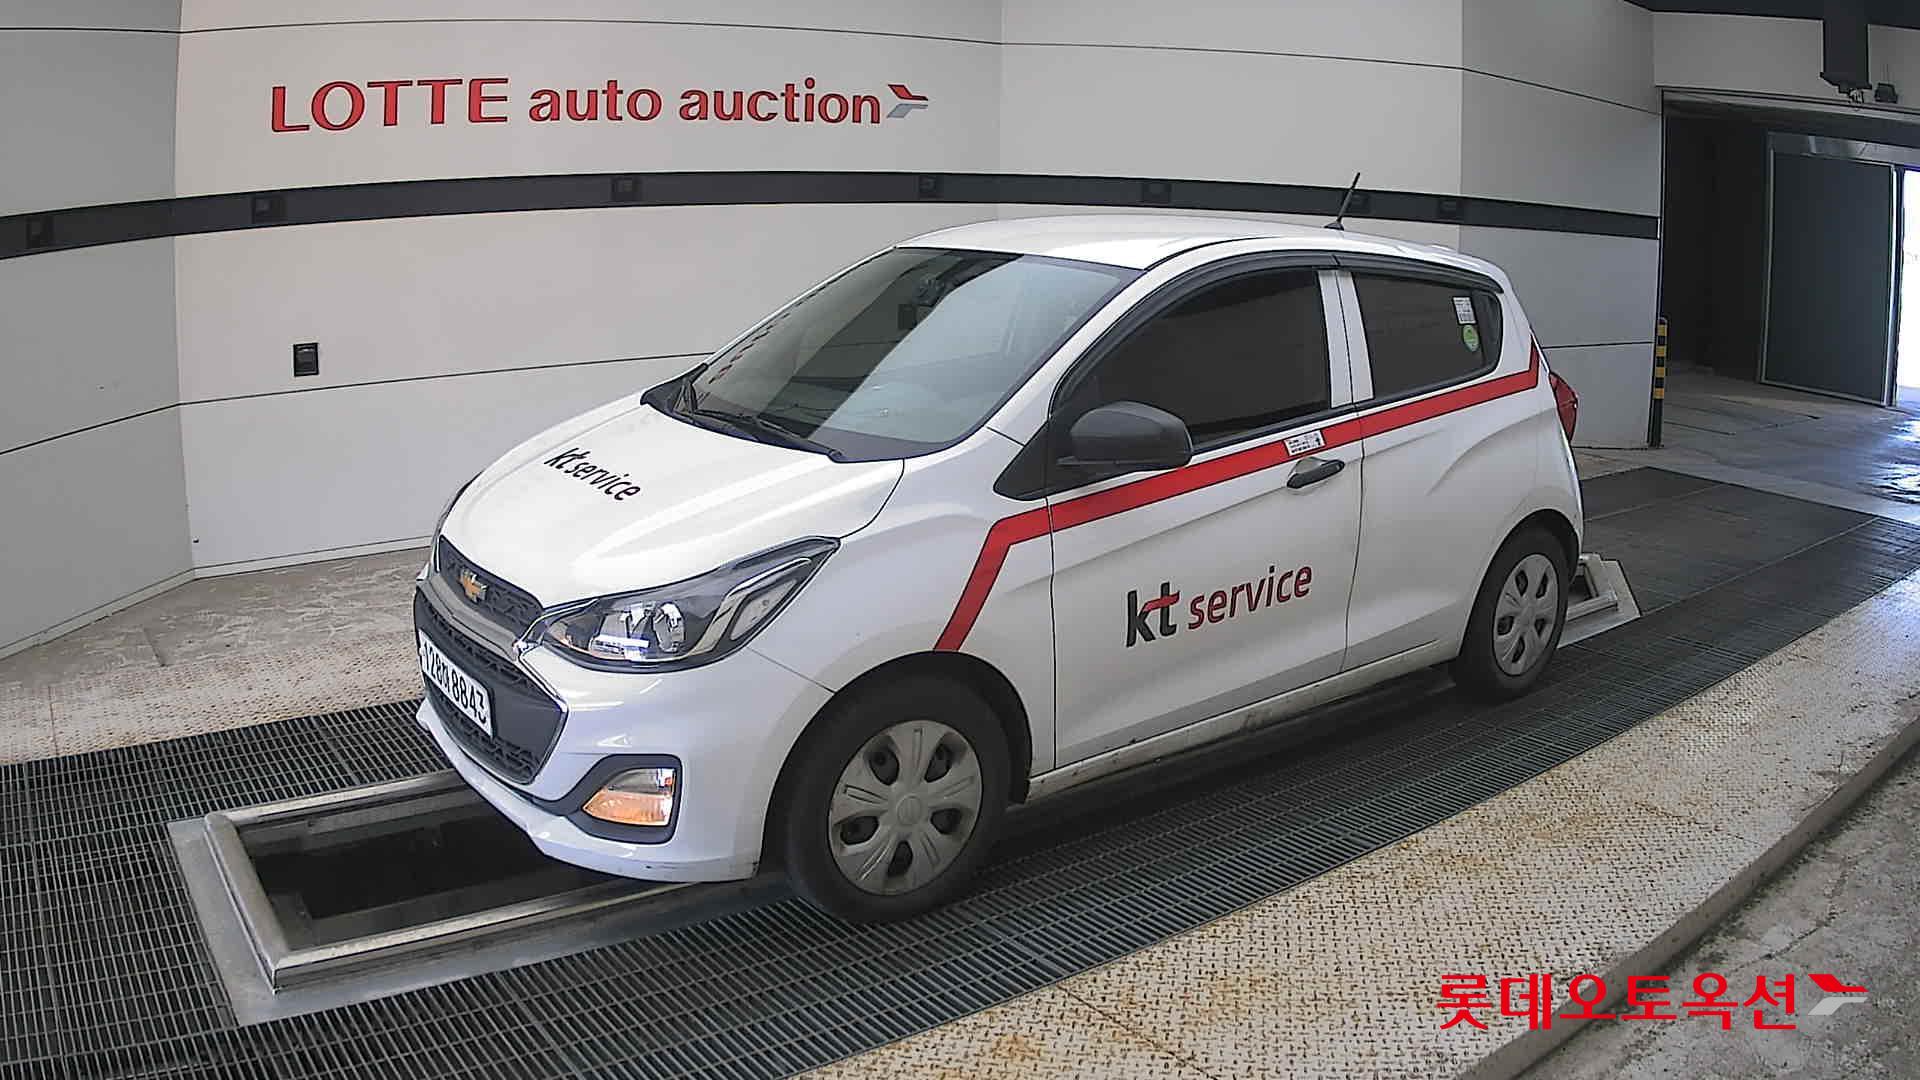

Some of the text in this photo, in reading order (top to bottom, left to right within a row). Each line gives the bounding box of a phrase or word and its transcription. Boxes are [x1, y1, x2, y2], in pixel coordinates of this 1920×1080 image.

[270, 77, 881, 133] LOTTE auto auction
[543, 447, 641, 501] kt service
[1125, 565, 1312, 648] kt service
[451, 670, 487, 724] 8843
